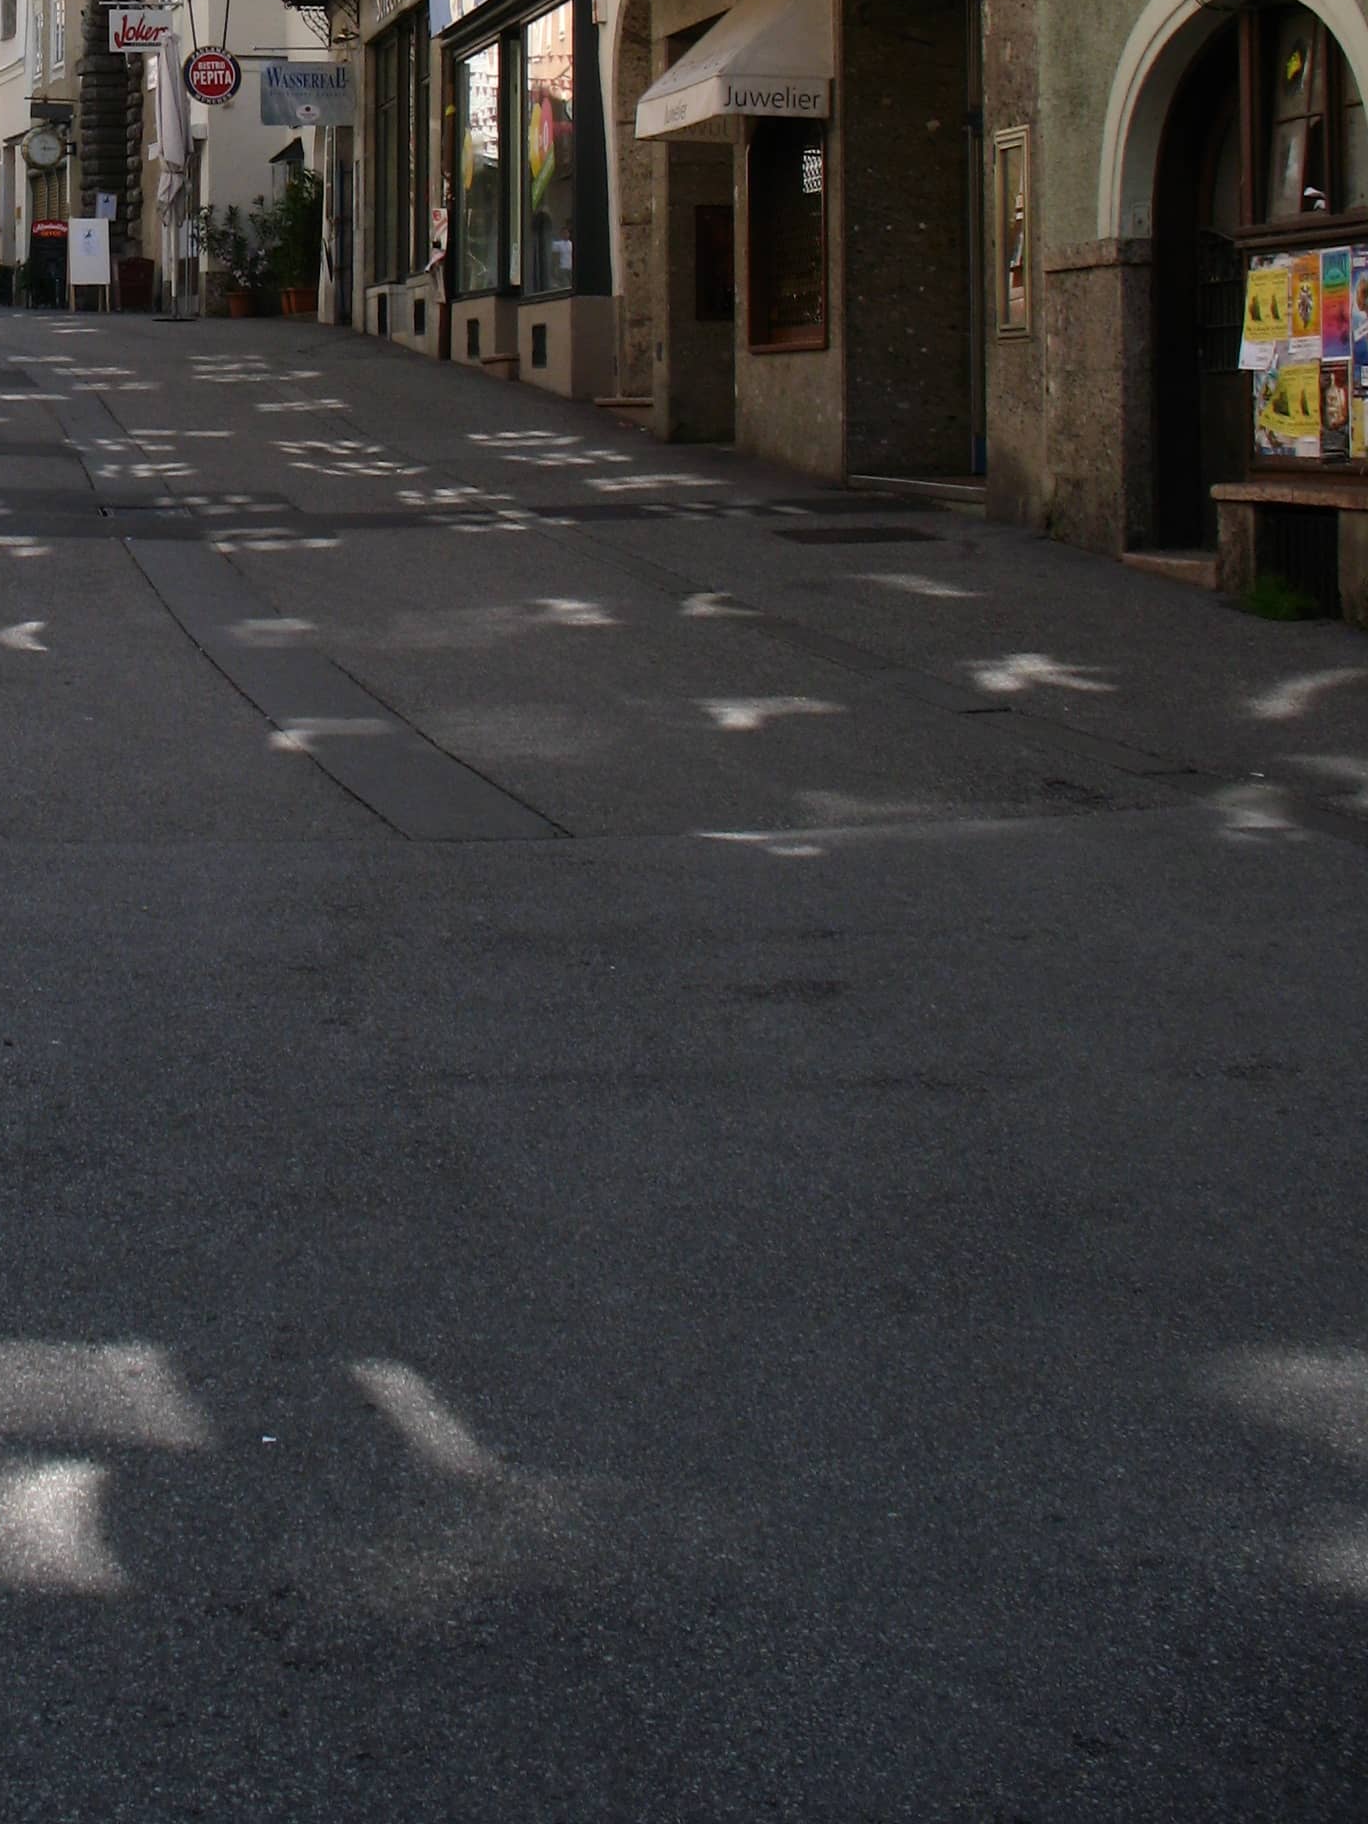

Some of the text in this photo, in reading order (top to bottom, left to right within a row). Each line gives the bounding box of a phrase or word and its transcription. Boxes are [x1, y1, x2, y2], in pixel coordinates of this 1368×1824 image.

[114, 14, 169, 49] Joker
[192, 70, 232, 86] PEPITA
[723, 85, 822, 111] Juwelier
